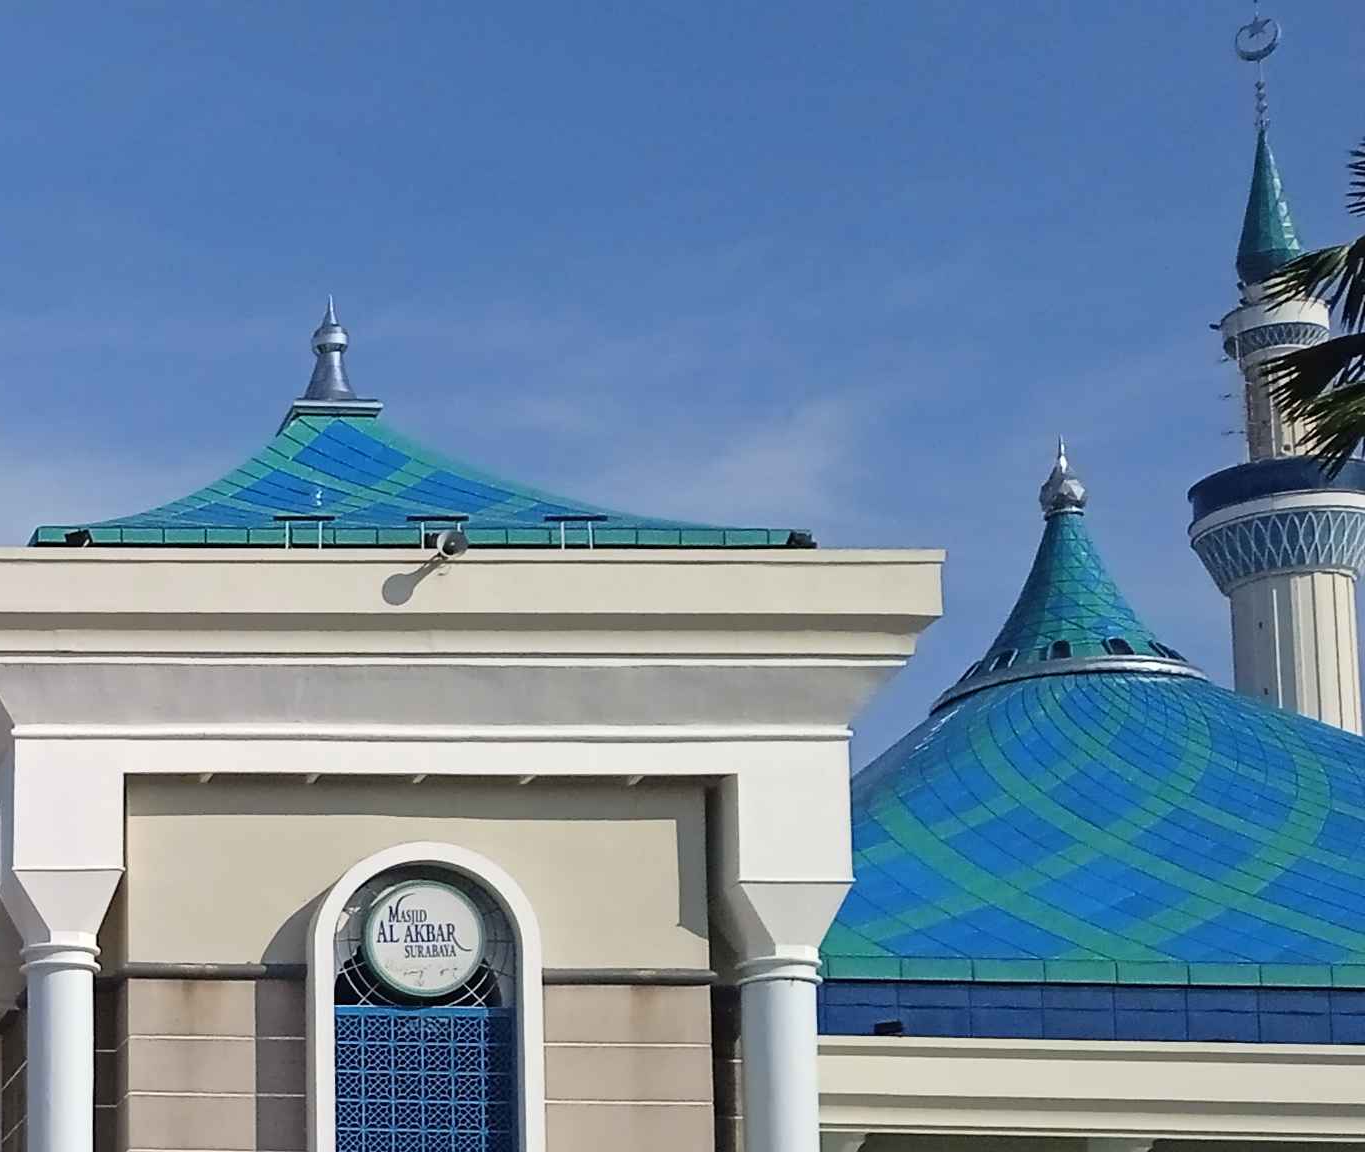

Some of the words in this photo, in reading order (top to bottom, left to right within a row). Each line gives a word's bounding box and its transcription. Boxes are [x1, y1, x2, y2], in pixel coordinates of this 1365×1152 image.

[388, 896, 428, 924] MASJID
[376, 920, 400, 943] AL
[403, 923, 467, 948] AKBAR
[404, 944, 457, 958] SURABAYA
